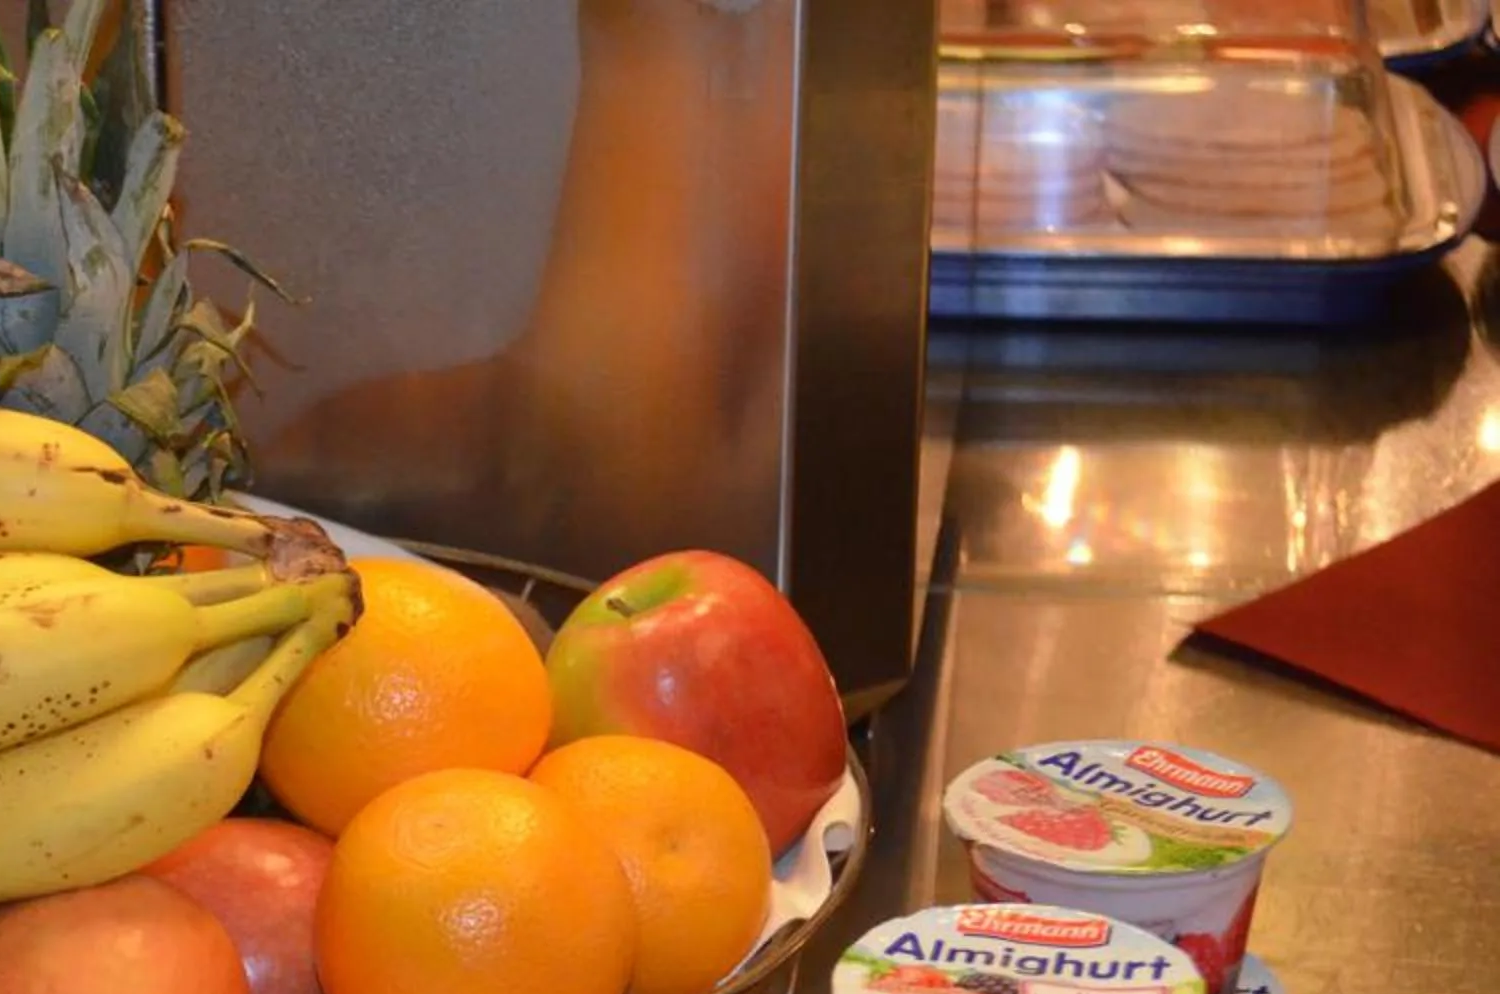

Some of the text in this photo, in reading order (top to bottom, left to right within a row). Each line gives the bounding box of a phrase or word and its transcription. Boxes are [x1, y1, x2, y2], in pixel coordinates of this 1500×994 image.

[1037, 751, 1272, 827] Almighurt
[1134, 750, 1245, 795] Ehrmann
[962, 909, 1100, 939] Ehrmann
[884, 932, 1171, 981] Almighurt
